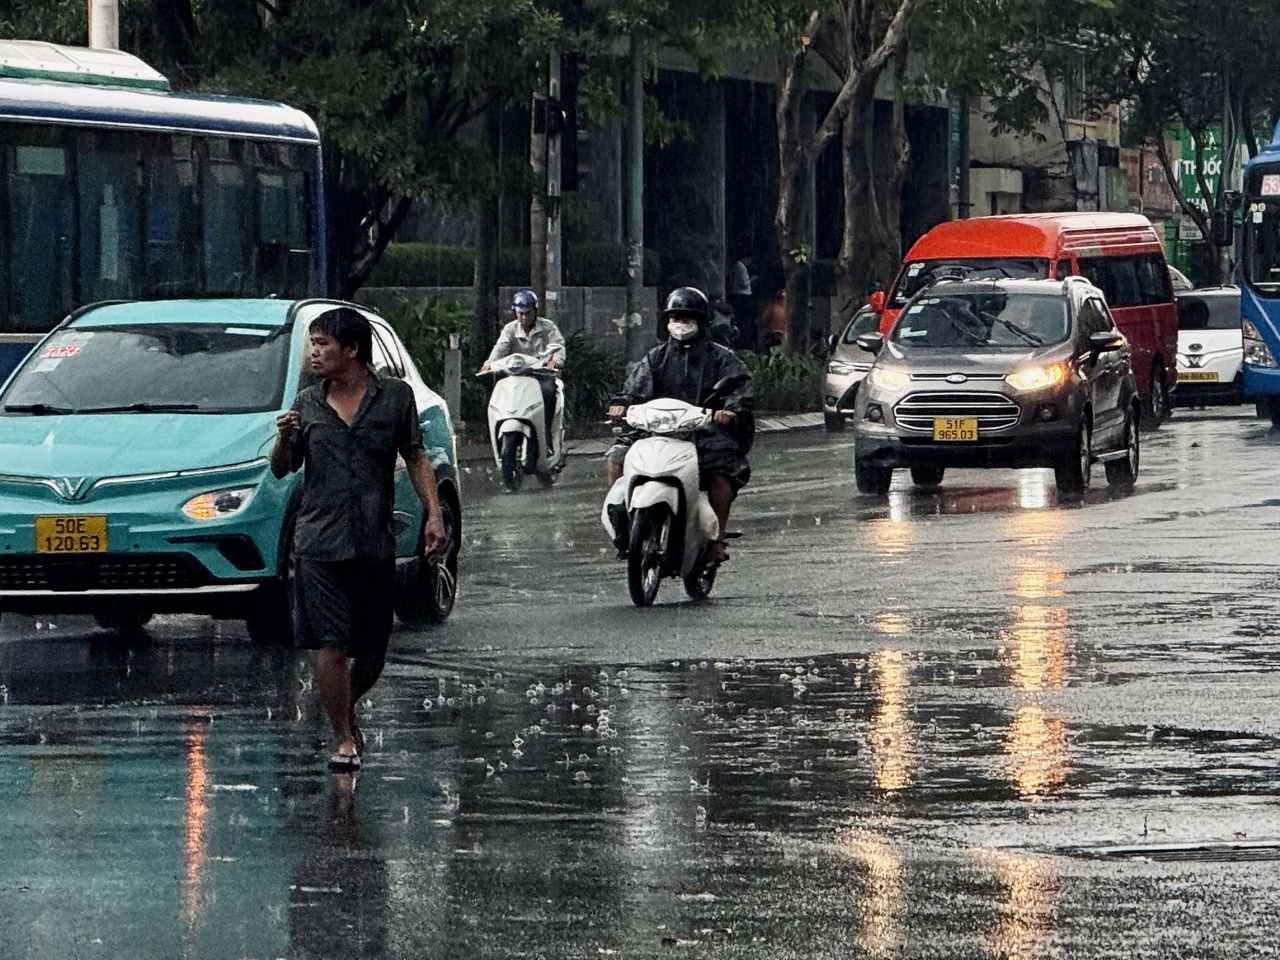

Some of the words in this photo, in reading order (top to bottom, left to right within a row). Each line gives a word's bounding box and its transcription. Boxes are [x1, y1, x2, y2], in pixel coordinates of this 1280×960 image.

[1264, 176, 1279, 194] 53
[946, 419, 965, 429] 51F
[938, 430, 974, 440] 965.03
[55, 518, 87, 534] 50E
[45, 535, 100, 552] 120.63
